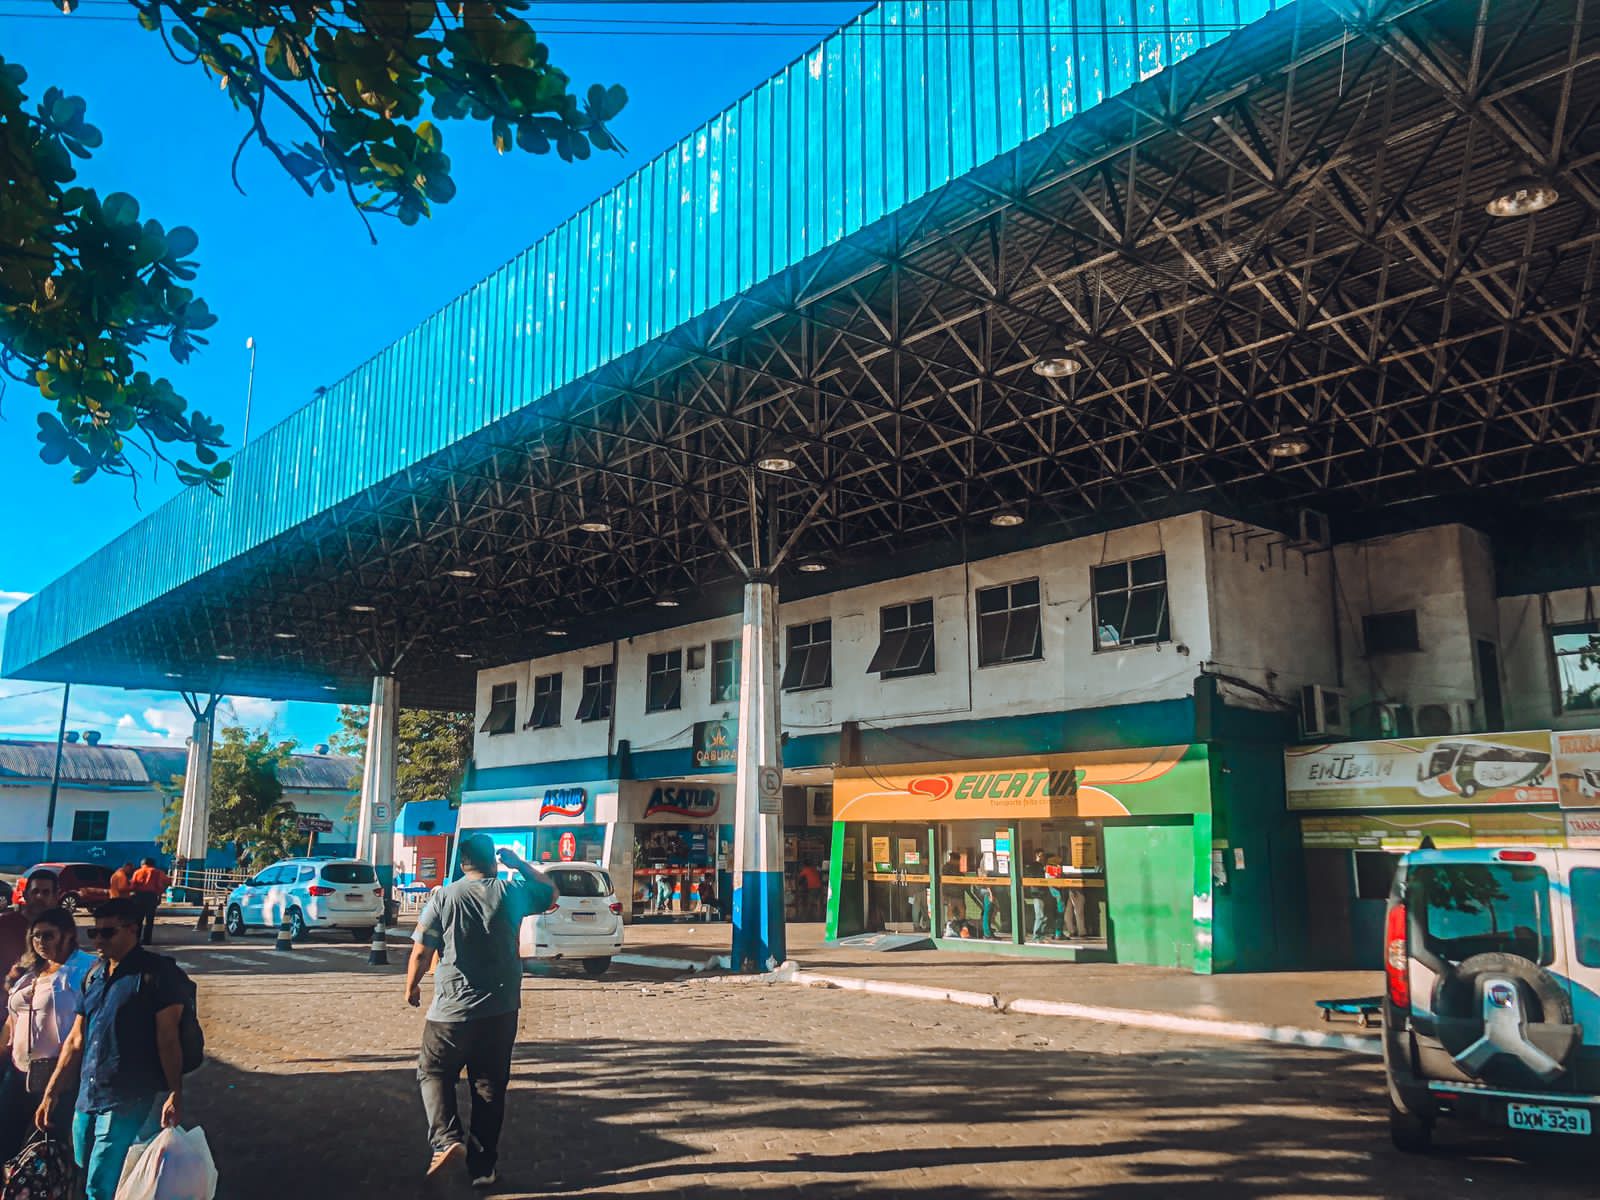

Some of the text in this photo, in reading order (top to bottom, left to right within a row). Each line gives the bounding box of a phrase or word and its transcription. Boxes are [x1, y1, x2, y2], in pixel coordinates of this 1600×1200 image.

[954, 770, 1087, 800] EUCATUR
[542, 787, 585, 808] ASATUR
[648, 787, 716, 809] ASATUR
